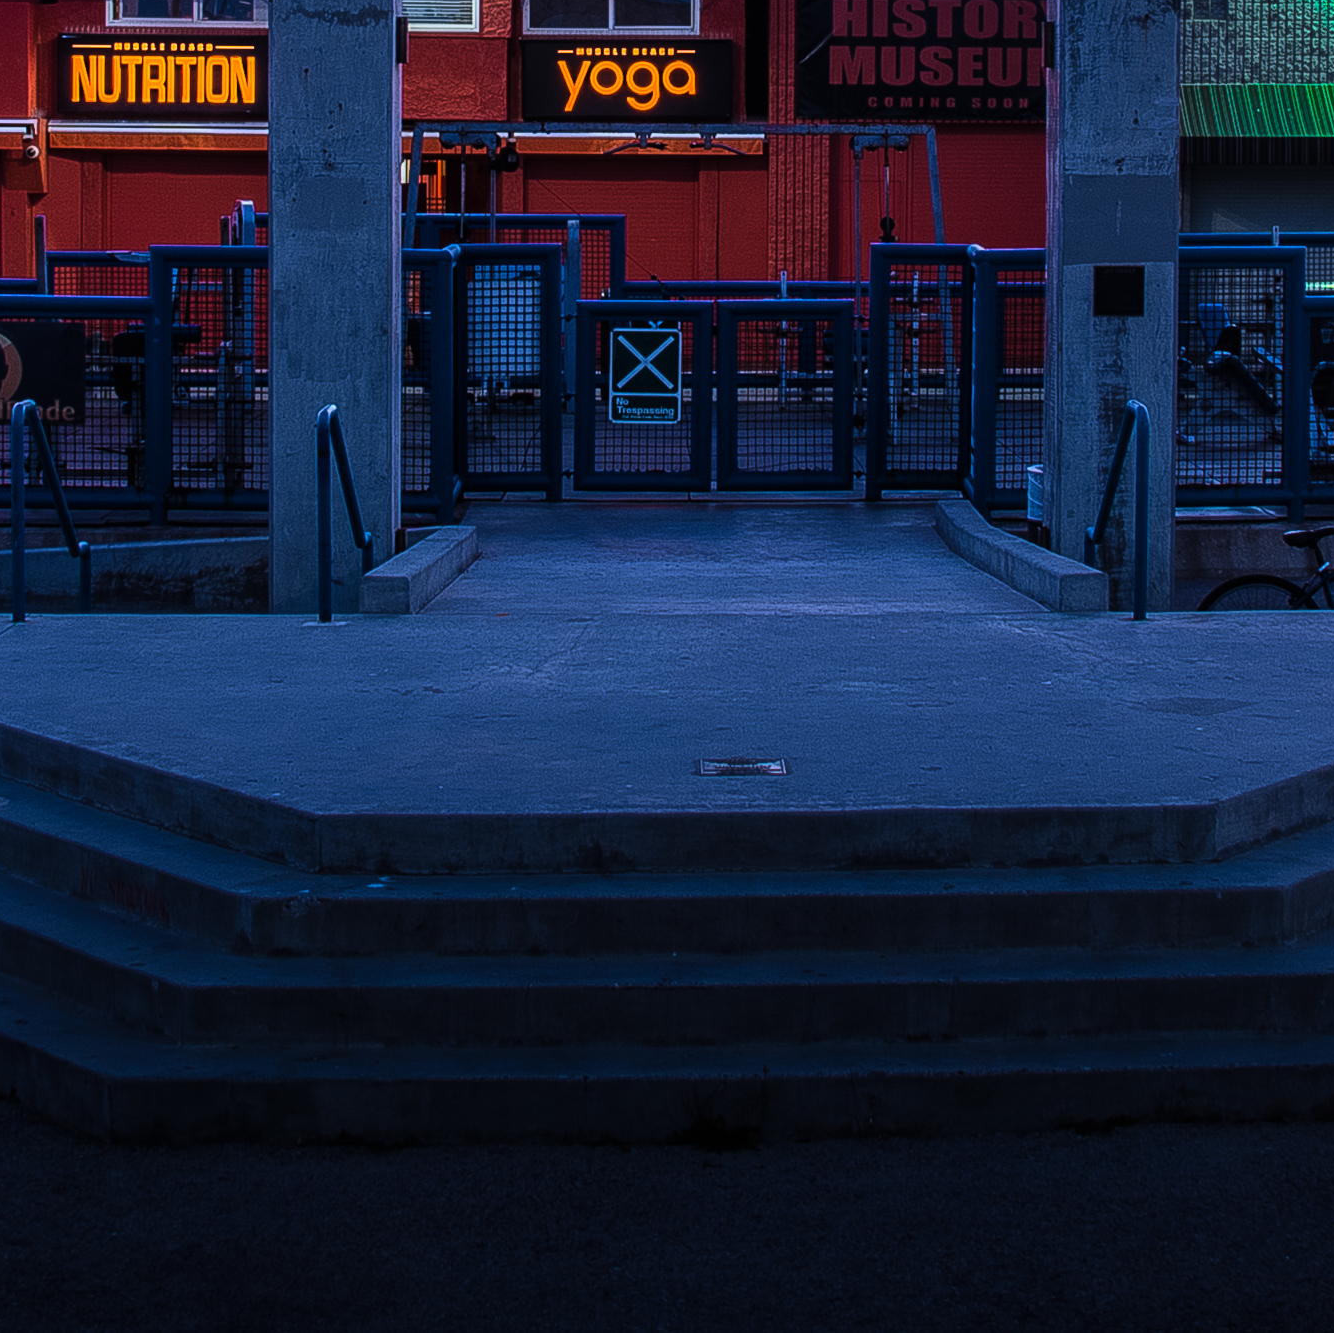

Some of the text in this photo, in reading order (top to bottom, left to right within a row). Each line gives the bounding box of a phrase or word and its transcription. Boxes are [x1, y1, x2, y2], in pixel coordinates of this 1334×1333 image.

[71, 54, 256, 104] NUTRITION
[557, 60, 696, 112] yoga
[867, 96, 1029, 109] COMING SOON
[616, 397, 629, 405] No
[616, 406, 675, 416] Trespassing
